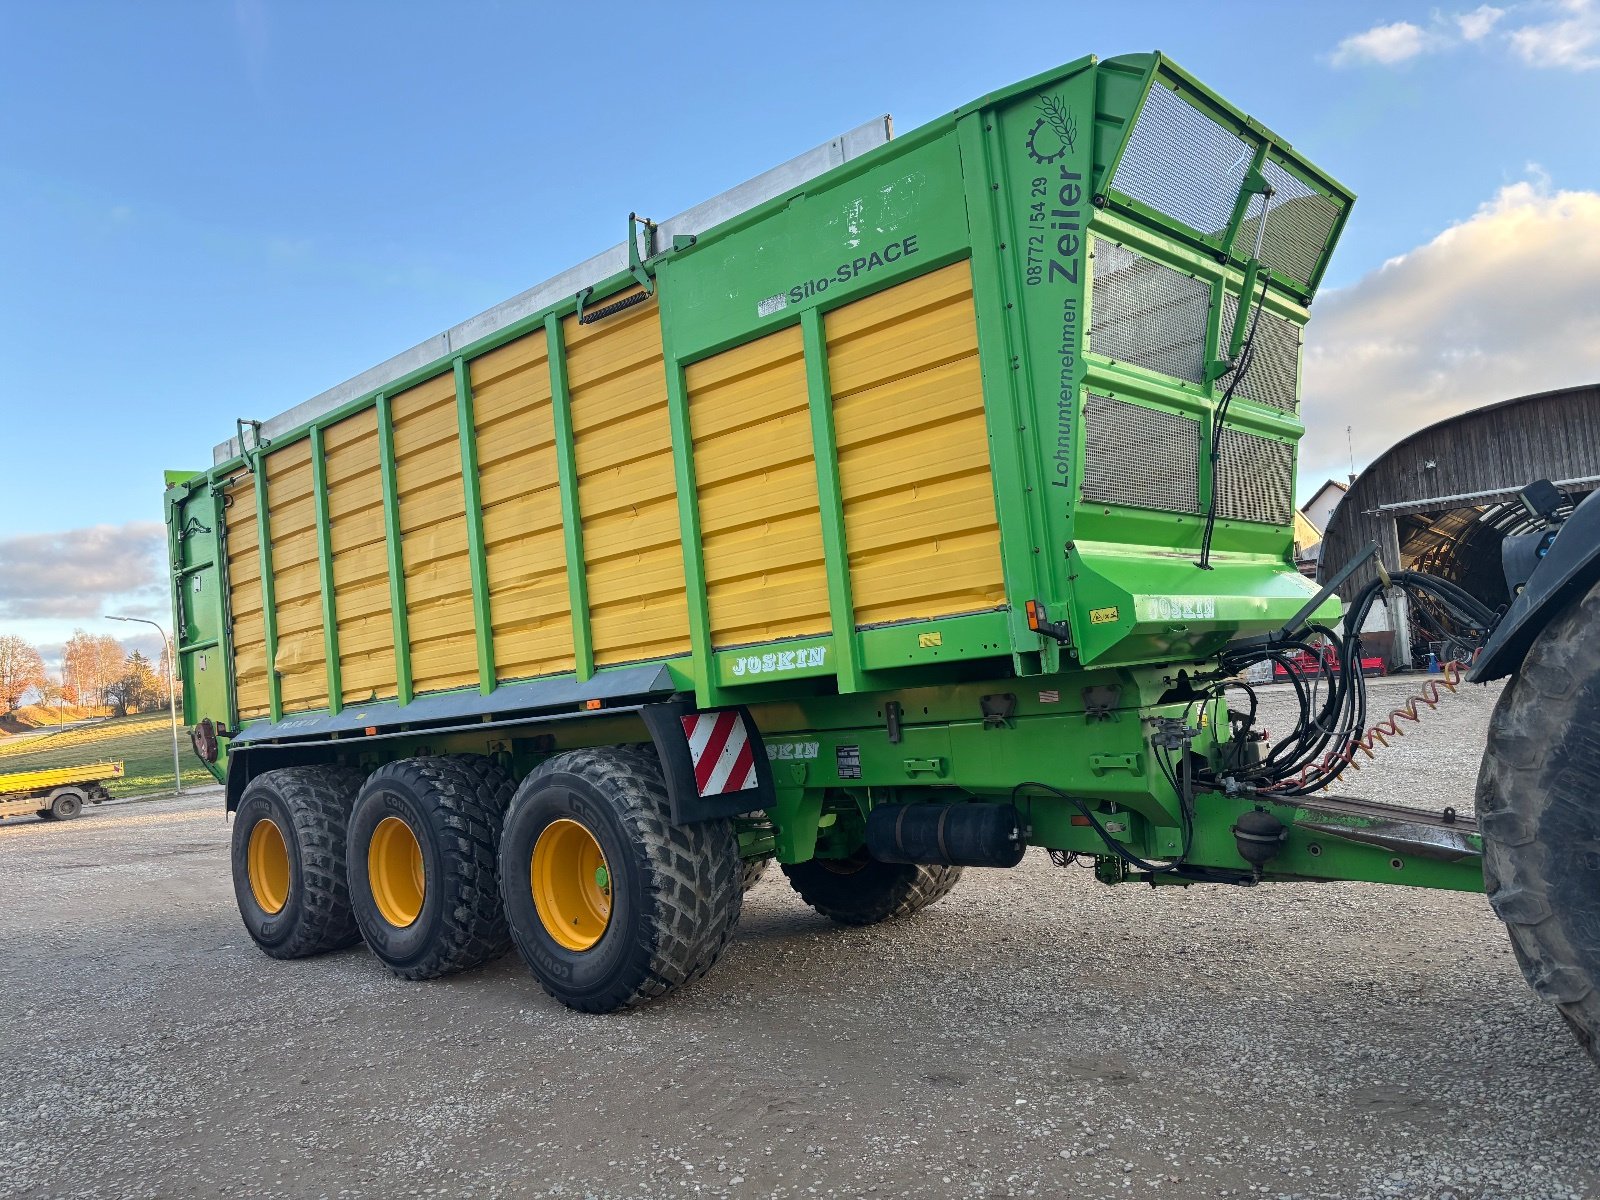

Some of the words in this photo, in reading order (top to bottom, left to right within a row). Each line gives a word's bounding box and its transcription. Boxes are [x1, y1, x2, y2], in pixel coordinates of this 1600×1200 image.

[1031, 177, 1047, 197] 29
[1030, 202, 1046, 221] 54
[1048, 164, 1082, 285] Zeiler
[788, 234, 920, 304] Silo-SPACE
[1027, 234, 1044, 286] 08772
[1052, 298, 1076, 488] Lohnunternehmen
[1148, 597, 1215, 620] JOSKIN
[732, 646, 827, 676] JOSKIN
[765, 741, 820, 760] SKIN
